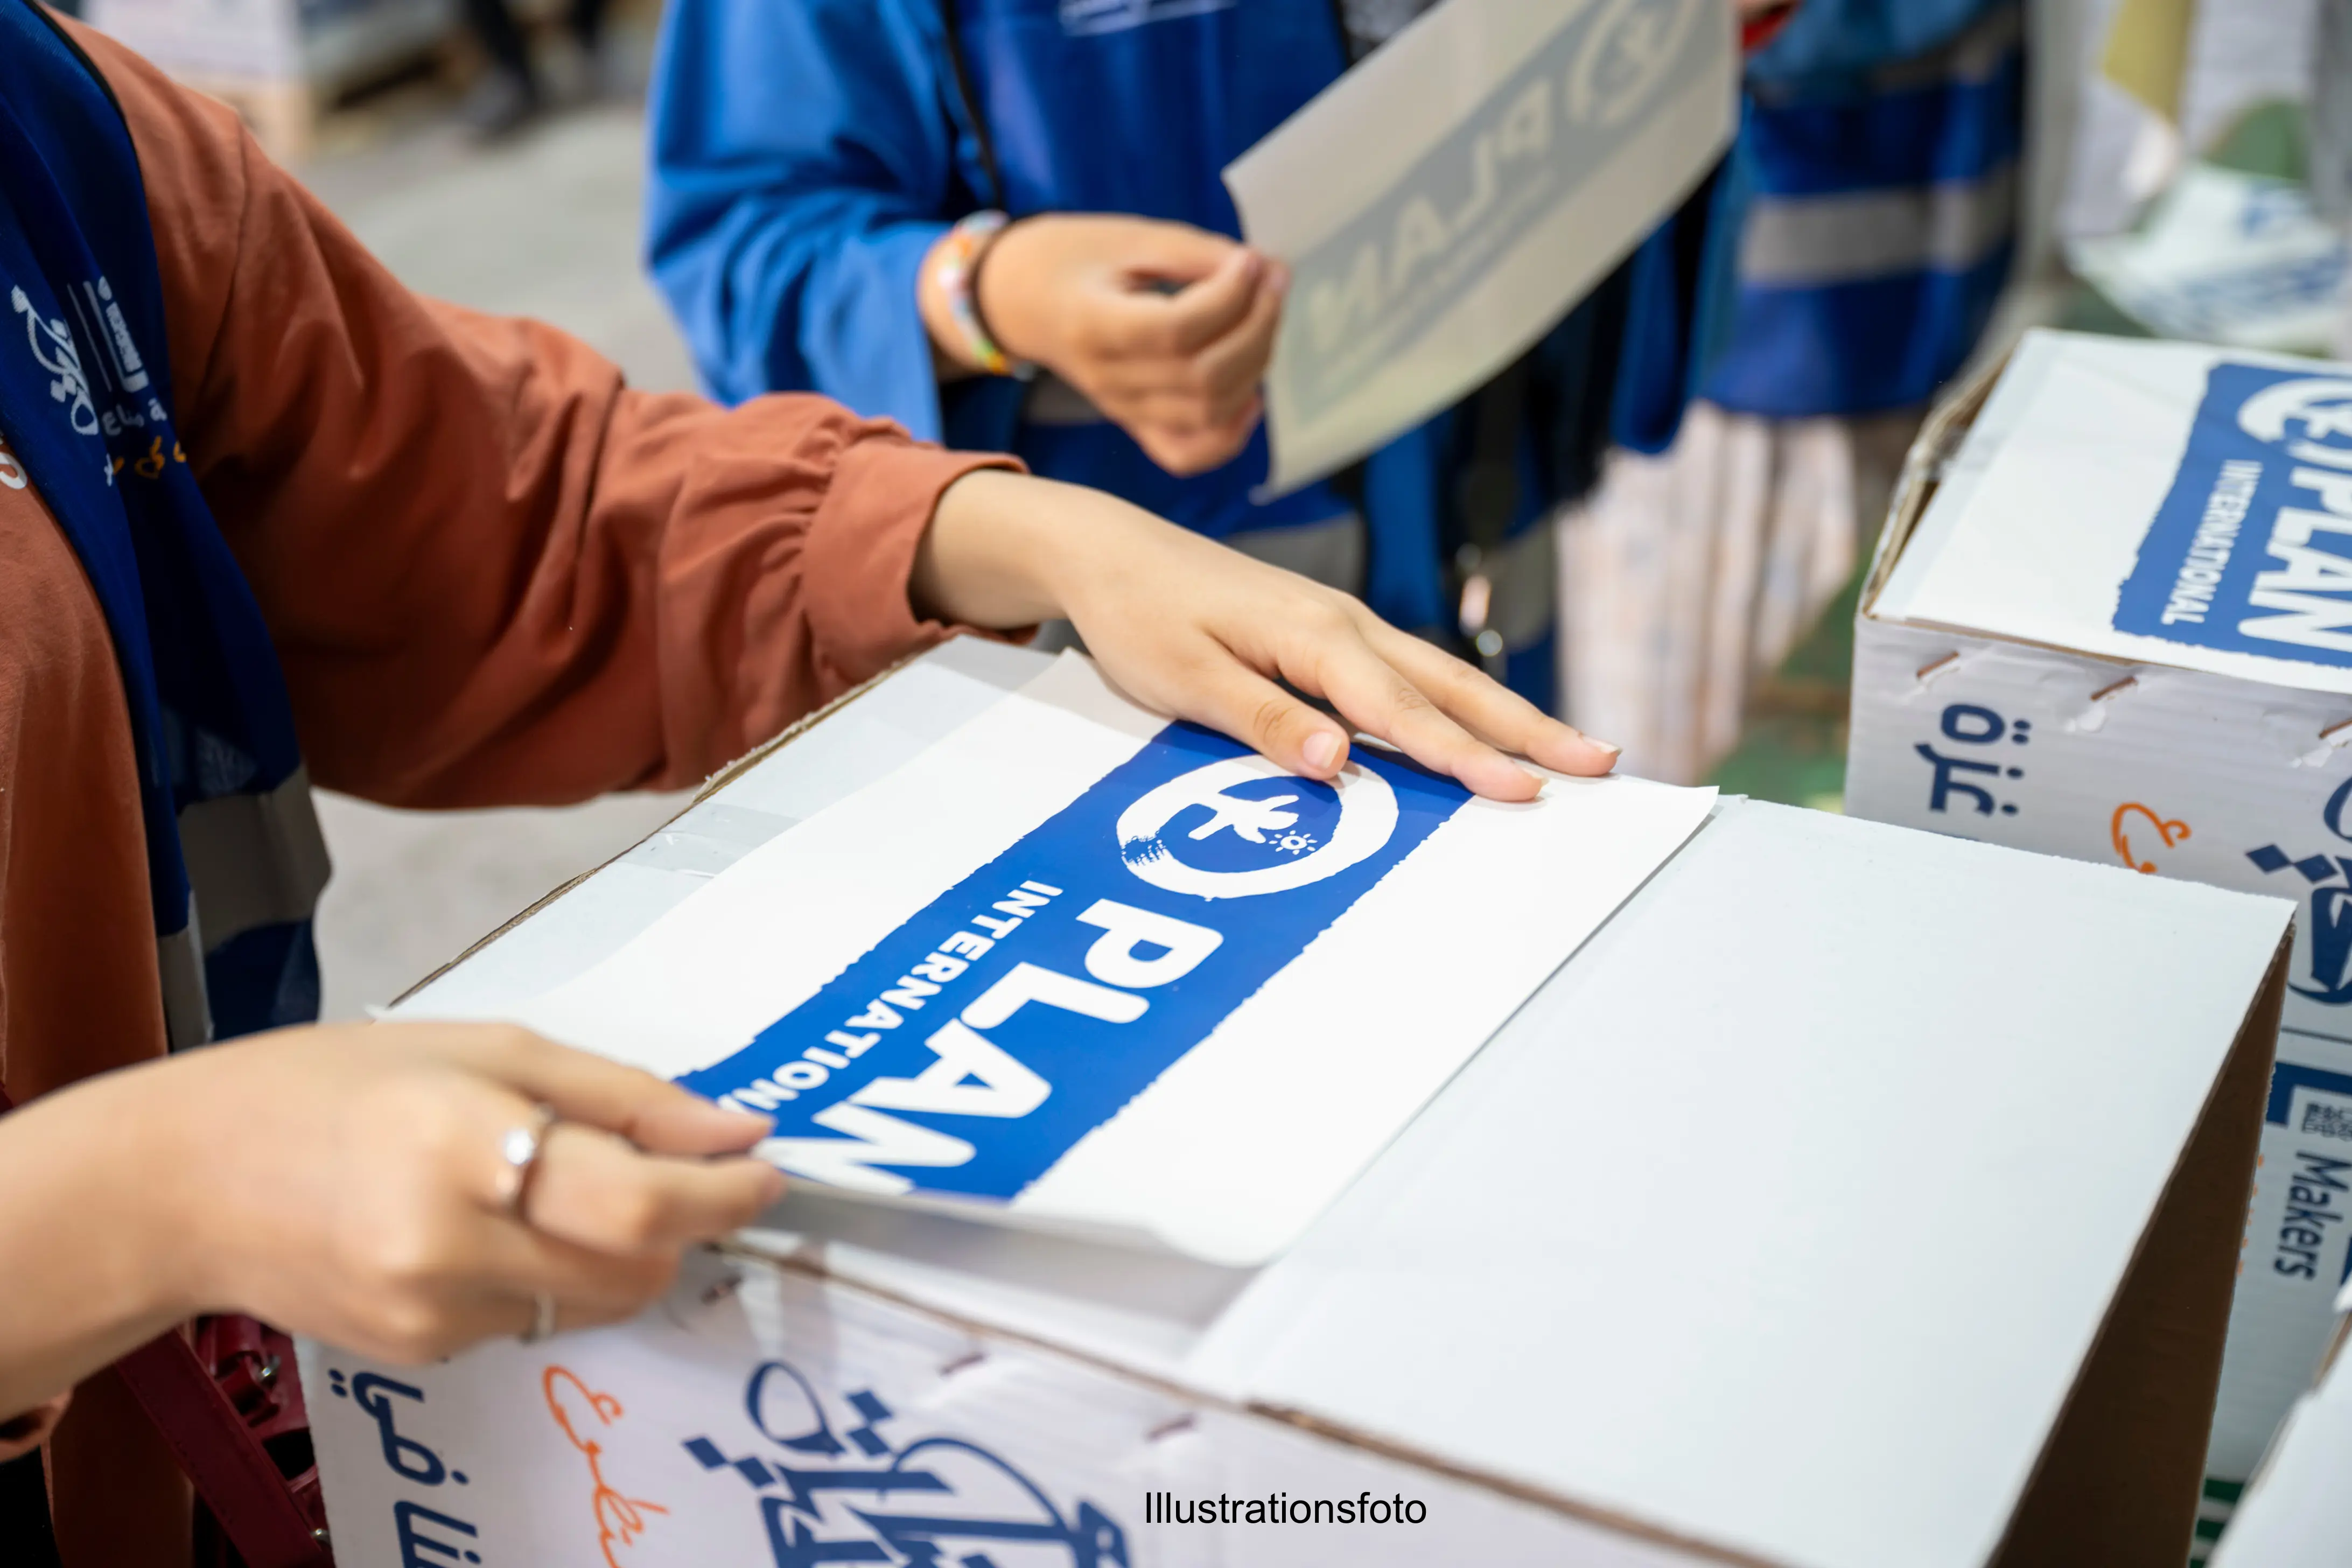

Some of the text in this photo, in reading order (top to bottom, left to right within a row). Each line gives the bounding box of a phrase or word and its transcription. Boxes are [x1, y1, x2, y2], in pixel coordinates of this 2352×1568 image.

[2161, 460, 2263, 625] INTERNATIONAL
[1914, 703, 2032, 816] غزة
[717, 880, 1063, 1114] INTERNATION
[752, 899, 1224, 1194] PLAN
[2273, 1150, 2352, 1280] Makers
[328, 1368, 470, 1486] في
